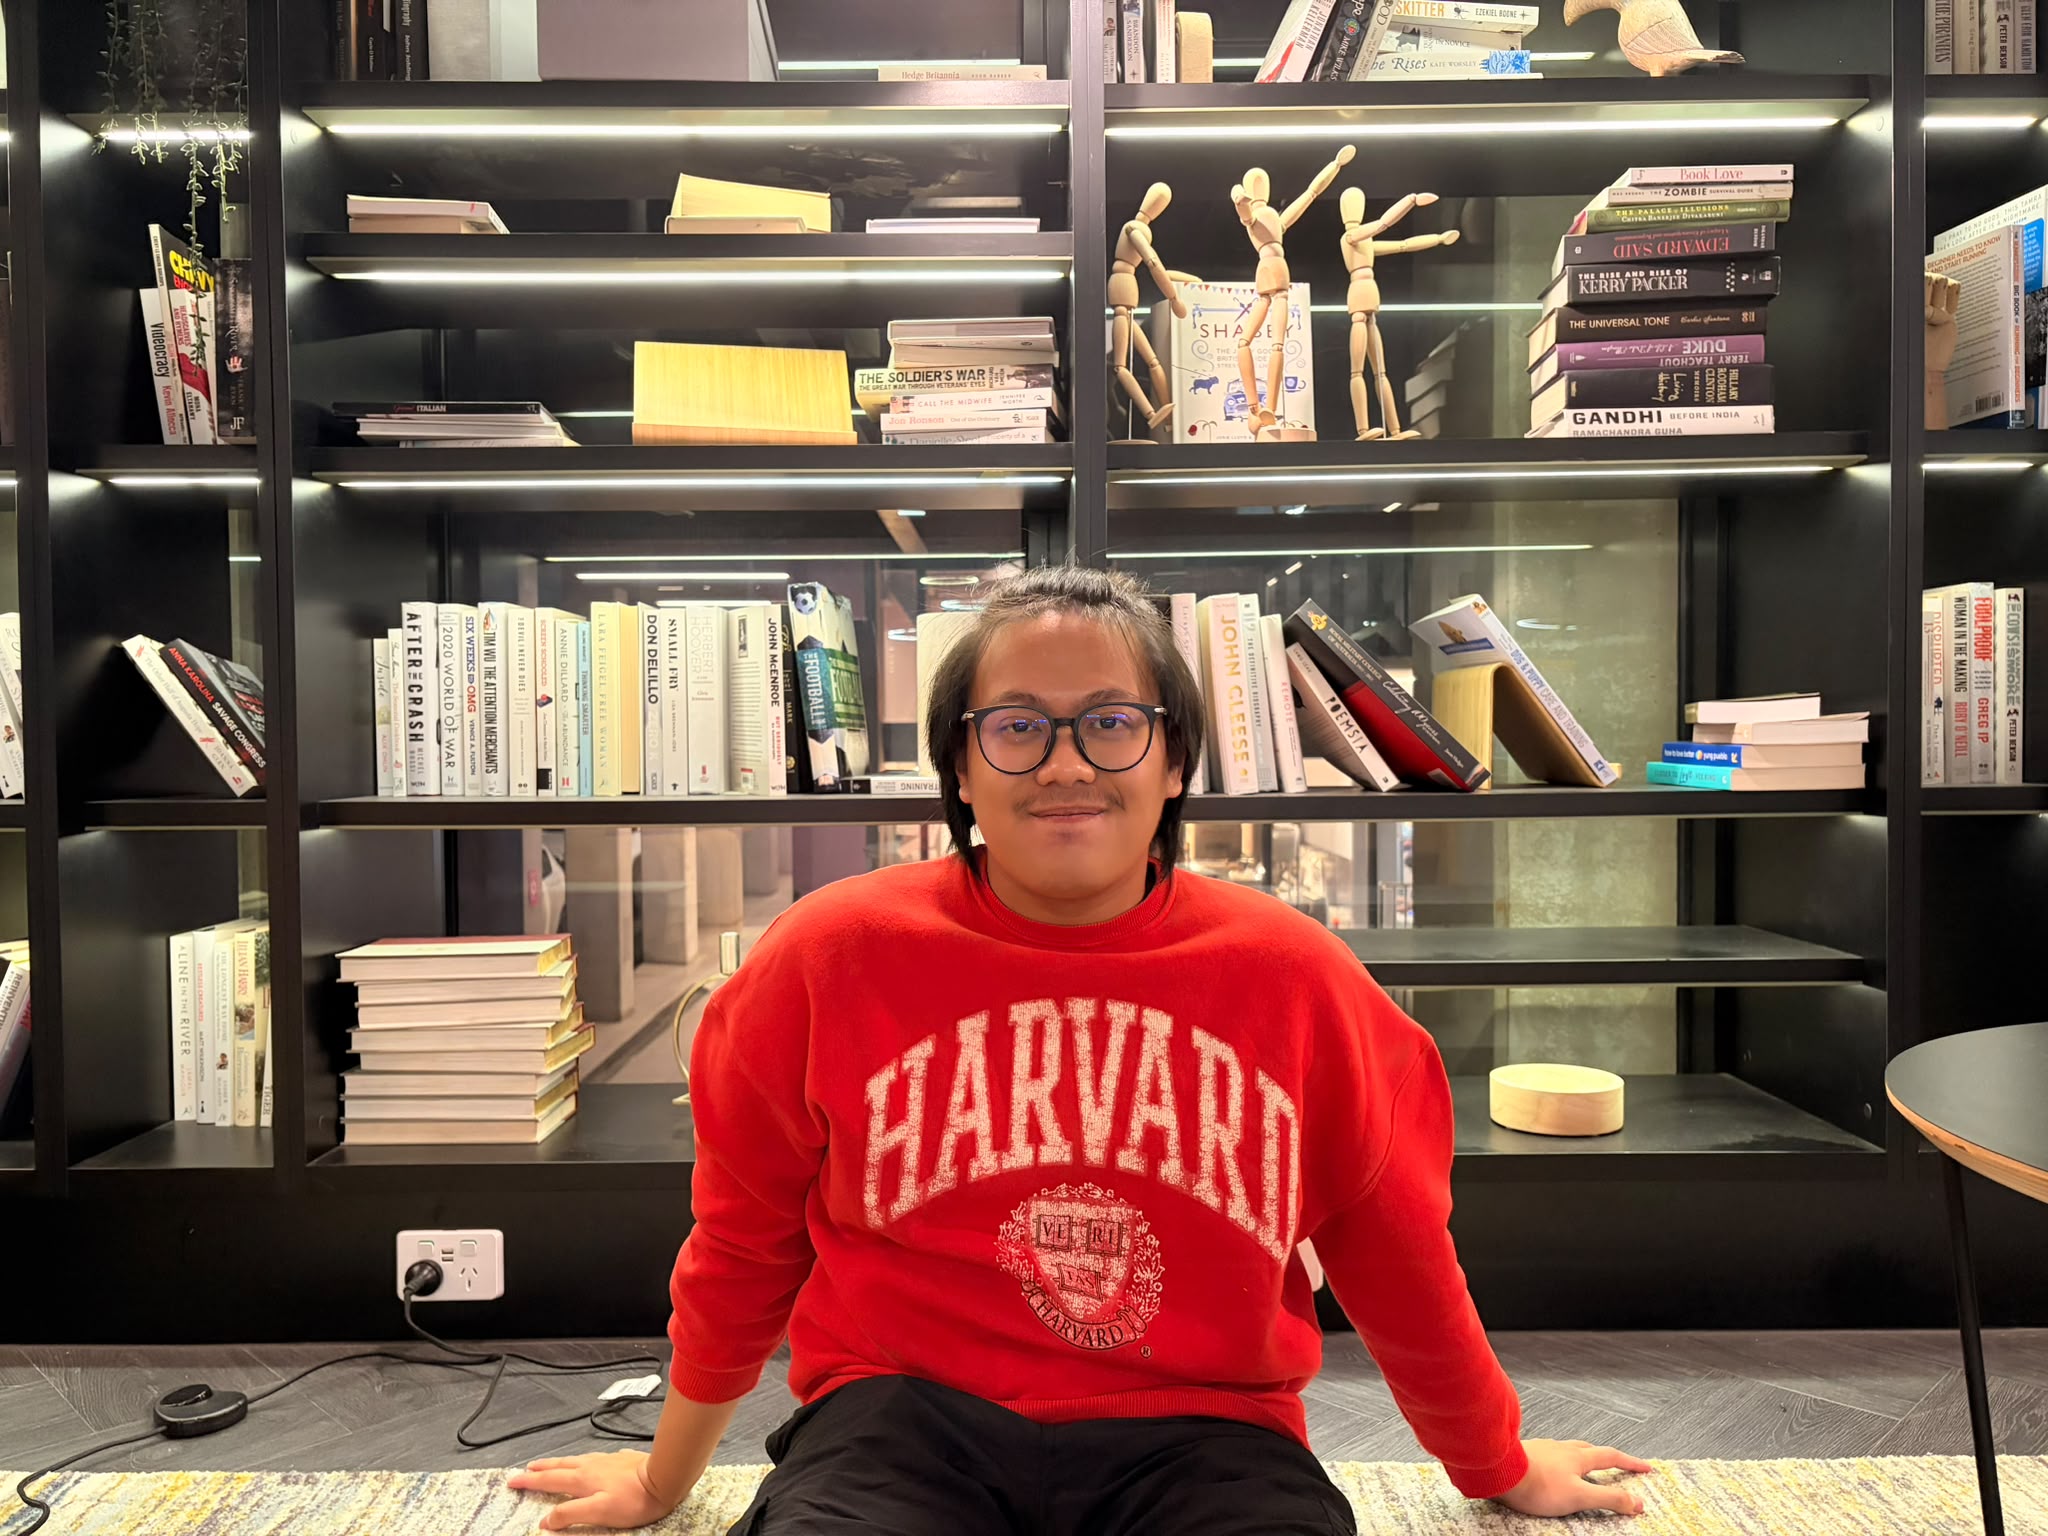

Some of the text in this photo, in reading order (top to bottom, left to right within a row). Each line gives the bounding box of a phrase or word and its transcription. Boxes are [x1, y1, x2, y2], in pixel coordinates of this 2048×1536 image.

[1298, 5, 1321, 49] KELLERMAN
[1396, 2, 1445, 17] SKITTER
[1475, 8, 1517, 18] EZEKIEL BOONE
[1307, 11, 1326, 51] JONATHAN
[1445, 38, 1470, 47] NOVICE
[1935, 17, 1951, 63] PIRANHAS
[902, 71, 960, 80] Hedge Britannia
[1330, 36, 1350, 81] MIKE WILKS
[1393, 57, 1426, 70] Rises
[1681, 168, 1743, 180] Book Love
[1664, 188, 1708, 197] ZOMBIE
[1613, 238, 1729, 258] EDWARD SAID
[1927, 235, 2001, 270] BEGINNER NEEDS KNOW
[1943, 248, 1987, 271] START RUNNING
[1578, 275, 1688, 295] KERRY PACKER
[175, 321, 184, 346] HYMENS
[180, 305, 191, 347] HEADSCARVES
[1569, 316, 1670, 329] THE UNIVERSAL TONE
[151, 322, 169, 378] Videocracy
[1660, 355, 1750, 367] TERRY TEACHOUT
[1682, 339, 1727, 354] DUKE
[859, 368, 985, 385] THE SOLDIER'S WAR
[1668, 373, 1686, 401] Living
[1705, 368, 1716, 403] CLINTON
[1717, 368, 1727, 402] RODHAM
[1729, 369, 1739, 401] HILLARY
[162, 385, 177, 435] Kevin Allocca
[186, 392, 195, 421] ELTAHAWY
[193, 396, 201, 412] MONA
[417, 404, 446, 413] ITALIAN
[889, 415, 945, 425] Jon Ronson
[918, 397, 993, 408] CALL THE MIDWIFE
[1573, 411, 1740, 425] GANDHI BEFORE INDIA
[1573, 428, 1683, 437] RAMACHANDRA GUHA
[560, 628, 568, 658] ANNIE
[702, 615, 713, 674] HERBERT
[1974, 597, 1993, 662] FOOLPROOF
[2007, 613, 2020, 641] COWS
[647, 615, 659, 704] DON DELILLO
[668, 618, 679, 691] SMALL FRY
[690, 616, 700, 674] HOOVER
[768, 617, 780, 707] JOHN McENROE
[1954, 597, 1967, 693] WOMAN IN THE MAKING
[407, 612, 424, 742] AFTER THE CRASH
[466, 616, 476, 713] SIX WEEKS OMG
[560, 662, 569, 702] DILLARD
[1249, 653, 1257, 688] DEFINITIVE
[2007, 648, 2016, 706] SMOKE
[443, 627, 455, 768] 2020 WORLD WAR
[483, 632, 498, 774] TIM WU THE ATTENTION MERCHANTS
[598, 613, 608, 768] LARA FREE WOMAN
[805, 659, 825, 719] FOOTBALL
[1221, 615, 1249, 762] JOHN CLEESE
[1281, 682, 1293, 722] REMOTE
[1510, 648, 1590, 749] DOG PUPPY CARE AND TRAINING
[169, 648, 266, 768] ANNA KAROLINA SAVAGE CONGRESS
[582, 704, 590, 735] SMARTER
[1252, 692, 1261, 727] BIOGRAPHY
[1325, 697, 1369, 753] POEMSIA
[1977, 698, 1989, 728] GREG
[1955, 702, 1968, 758] RORY O'NEILL
[1978, 732, 1989, 743] IP
[901, 782, 940, 791] TRAINING
[178, 953, 191, 1056] LINE THE RIVER
[863, 996, 1300, 1267] HARVARD
[1043, 1222, 1114, 1244] VE RI
[1037, 1300, 1124, 1347] HARVARD
